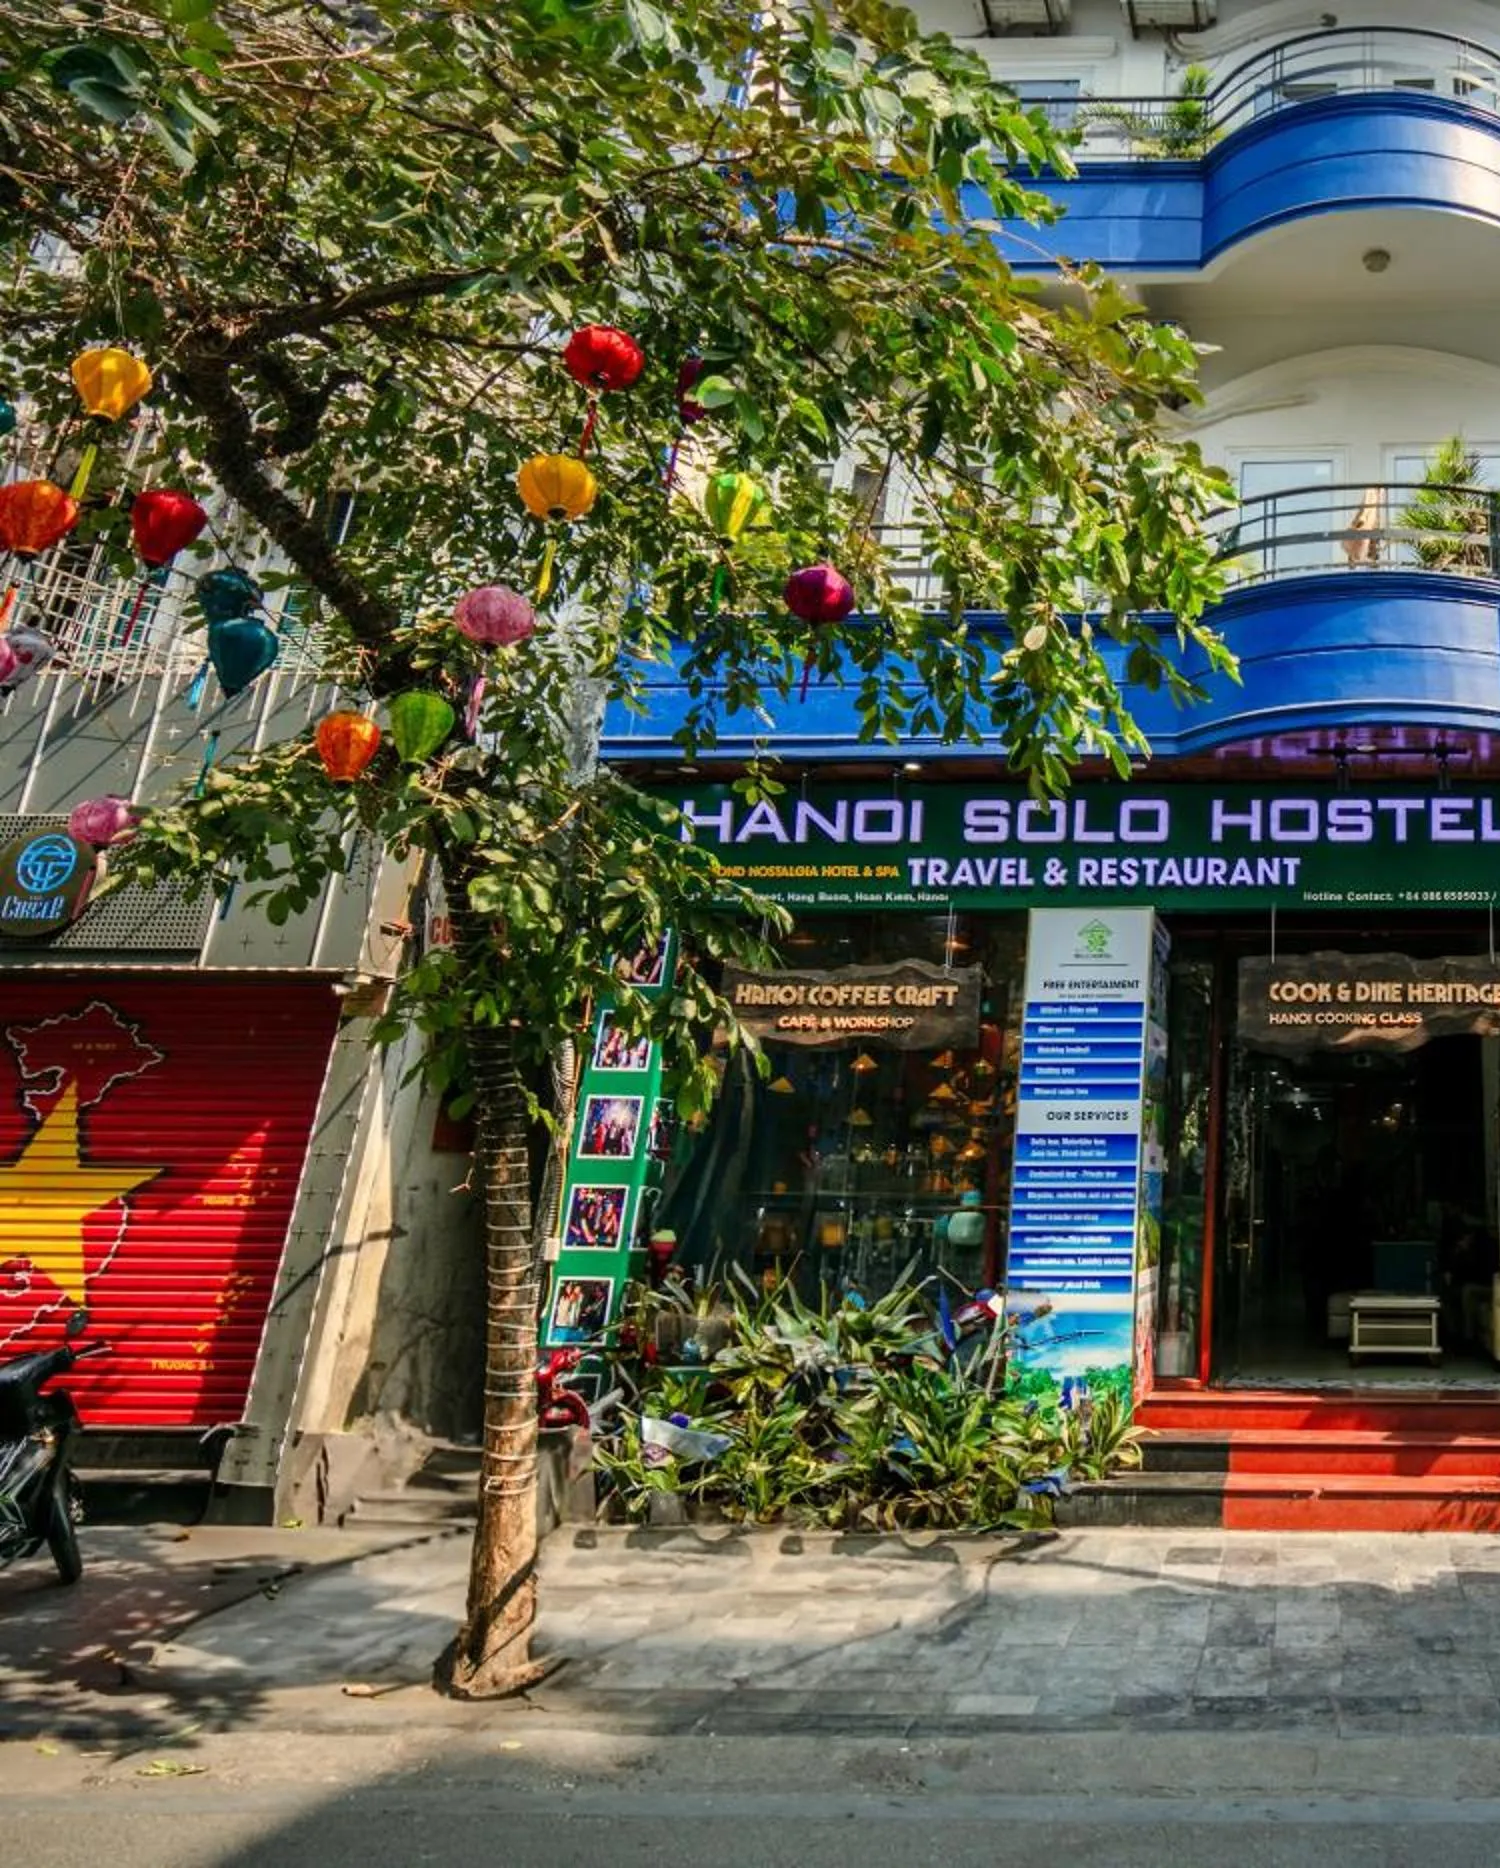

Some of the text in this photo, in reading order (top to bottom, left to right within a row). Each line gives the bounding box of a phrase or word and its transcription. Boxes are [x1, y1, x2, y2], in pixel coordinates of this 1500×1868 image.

[682, 798, 923, 844] HANOI
[963, 799, 1170, 844] SOLO
[822, 865, 860, 877] HOTEL
[875, 866, 899, 877] SPA
[907, 857, 1301, 886] TRAVEL & RESTAURANT
[1303, 890, 1343, 901] Hotline
[806, 983, 893, 1007] COFFEE
[893, 984, 959, 1007] CRAFT
[1268, 981, 1332, 1004] COOK
[1336, 982, 1351, 1003] &
[1355, 982, 1403, 1003] DINE
[833, 1015, 915, 1030] WORKSHOP
[1269, 1011, 1423, 1025] HANOI COOKING CLASS
[1046, 1111, 1129, 1122] OUR SERVICES
